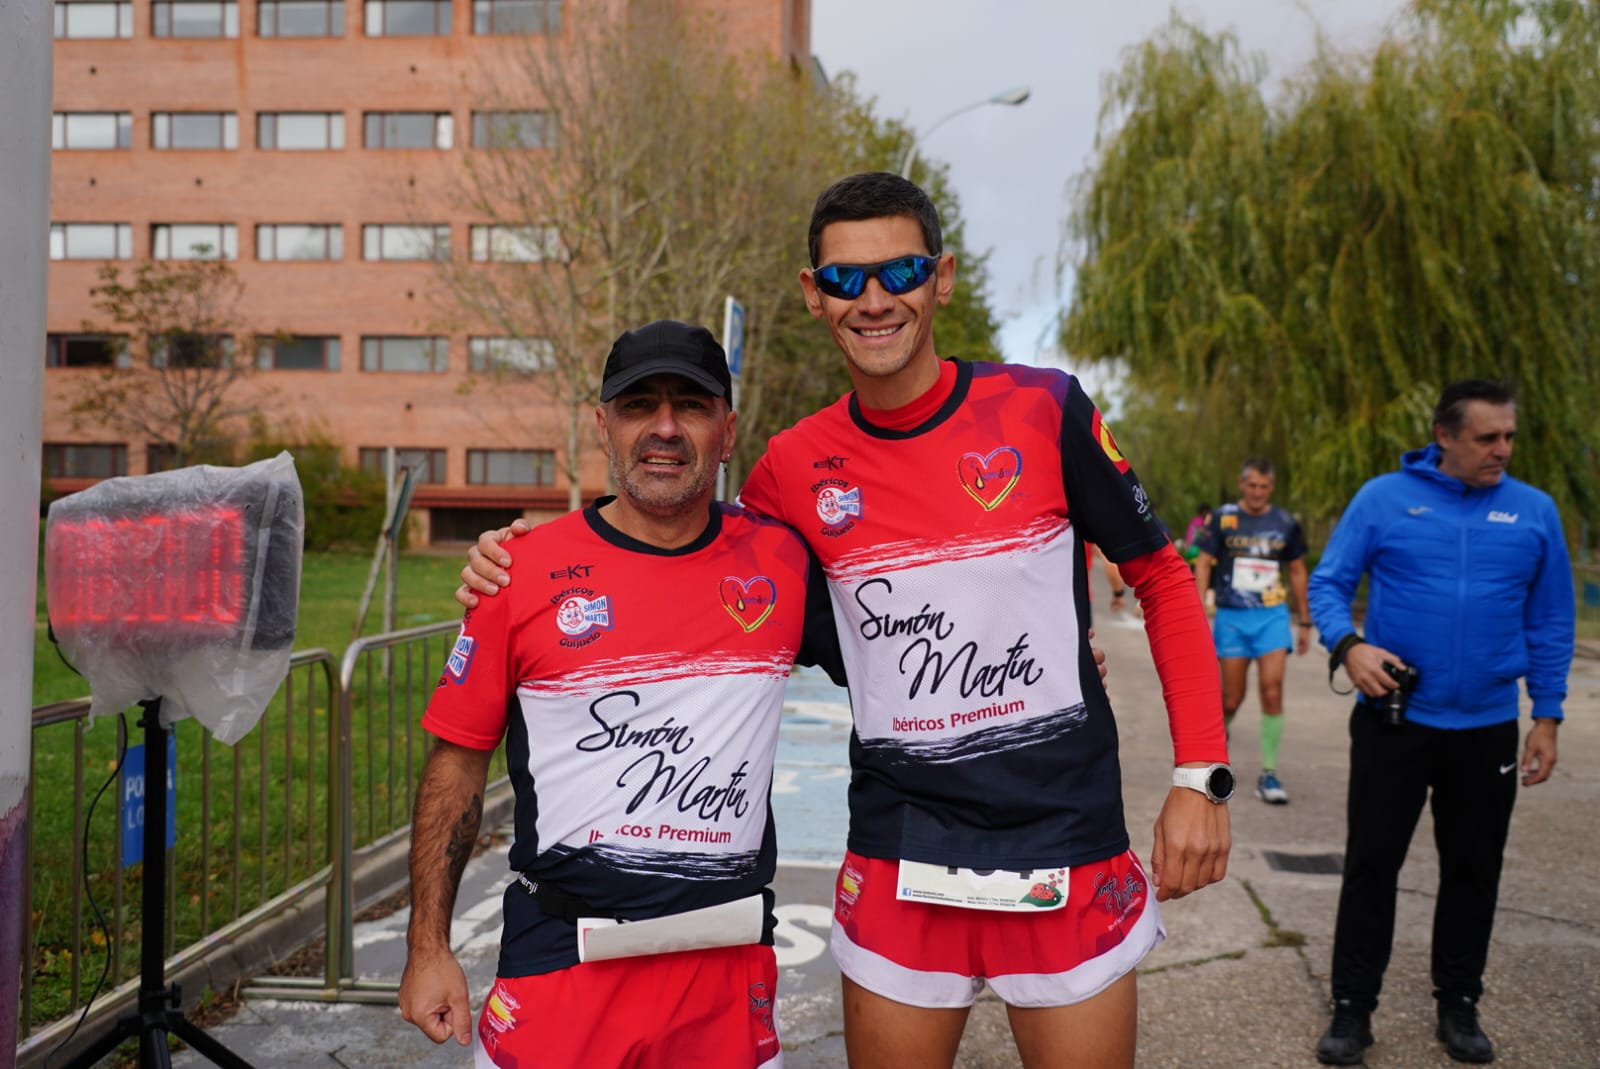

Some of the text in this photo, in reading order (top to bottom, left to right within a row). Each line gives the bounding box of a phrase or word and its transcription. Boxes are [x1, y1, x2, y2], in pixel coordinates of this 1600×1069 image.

[549, 564, 595, 580] EKT
[855, 577, 954, 641] Simón
[899, 632, 1044, 700] Martín
[576, 690, 695, 754] Simón
[892, 699, 1025, 732] Ibéricos Premium
[616, 749, 749, 823] Martín
[657, 824, 732, 843] Premium
